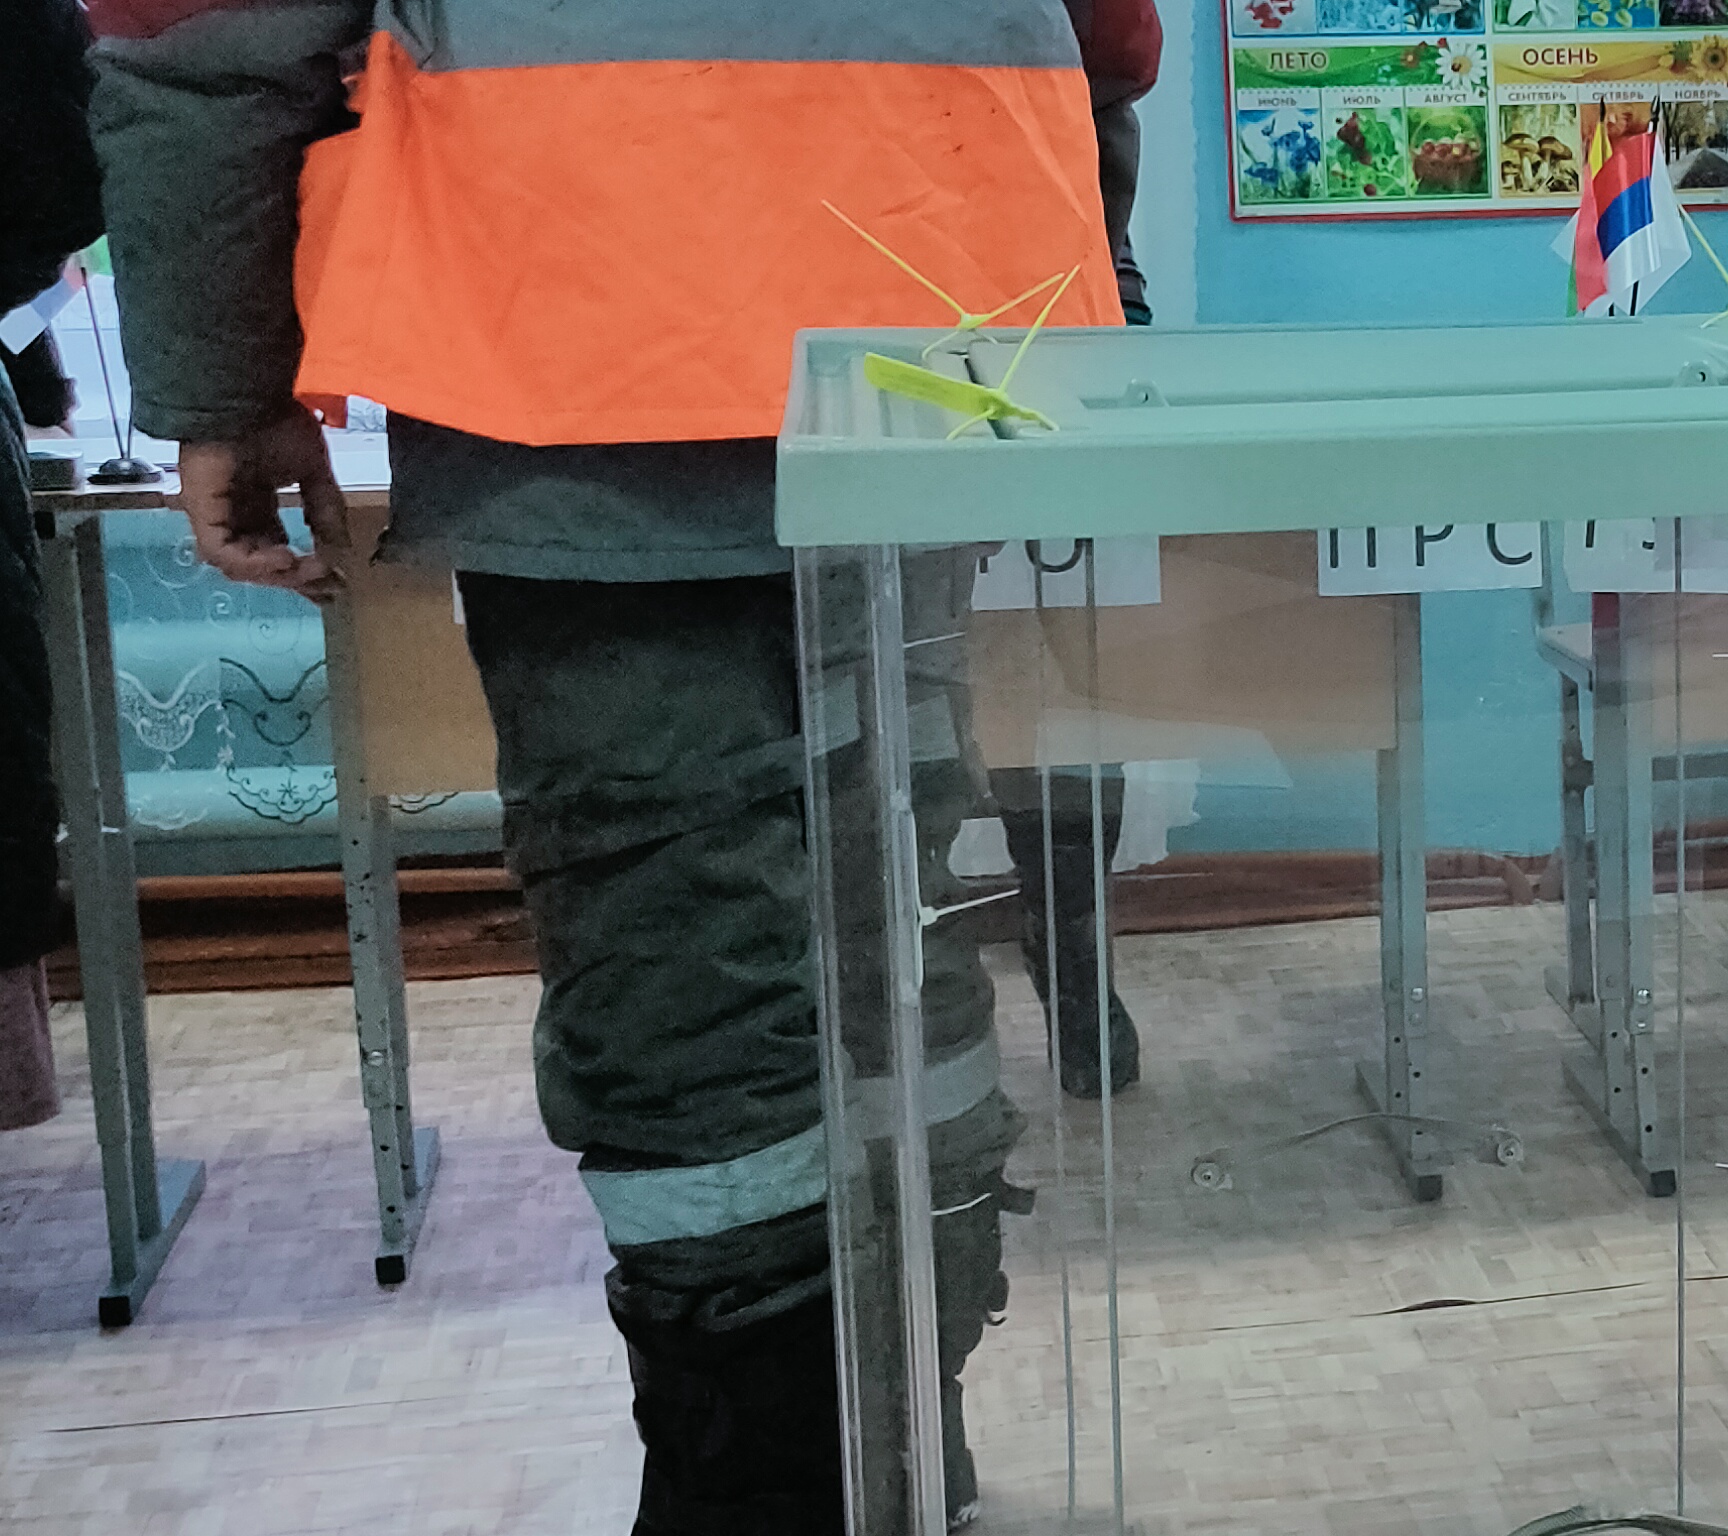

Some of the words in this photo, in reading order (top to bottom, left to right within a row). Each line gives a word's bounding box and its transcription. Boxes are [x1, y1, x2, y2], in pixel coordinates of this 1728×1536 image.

[1269, 51, 1328, 70] ЛЕТО
[1522, 47, 1599, 66] ОСЕНЬ
[1343, 94, 1381, 105] ИЮЛЬ
[1424, 92, 1468, 104] АВГУСТ
[1507, 91, 1567, 102] СЕНТЯБРЬ
[1592, 90, 1645, 101] ОКТЯБРЬ
[1674, 89, 1722, 100] НОЯБРЬ
